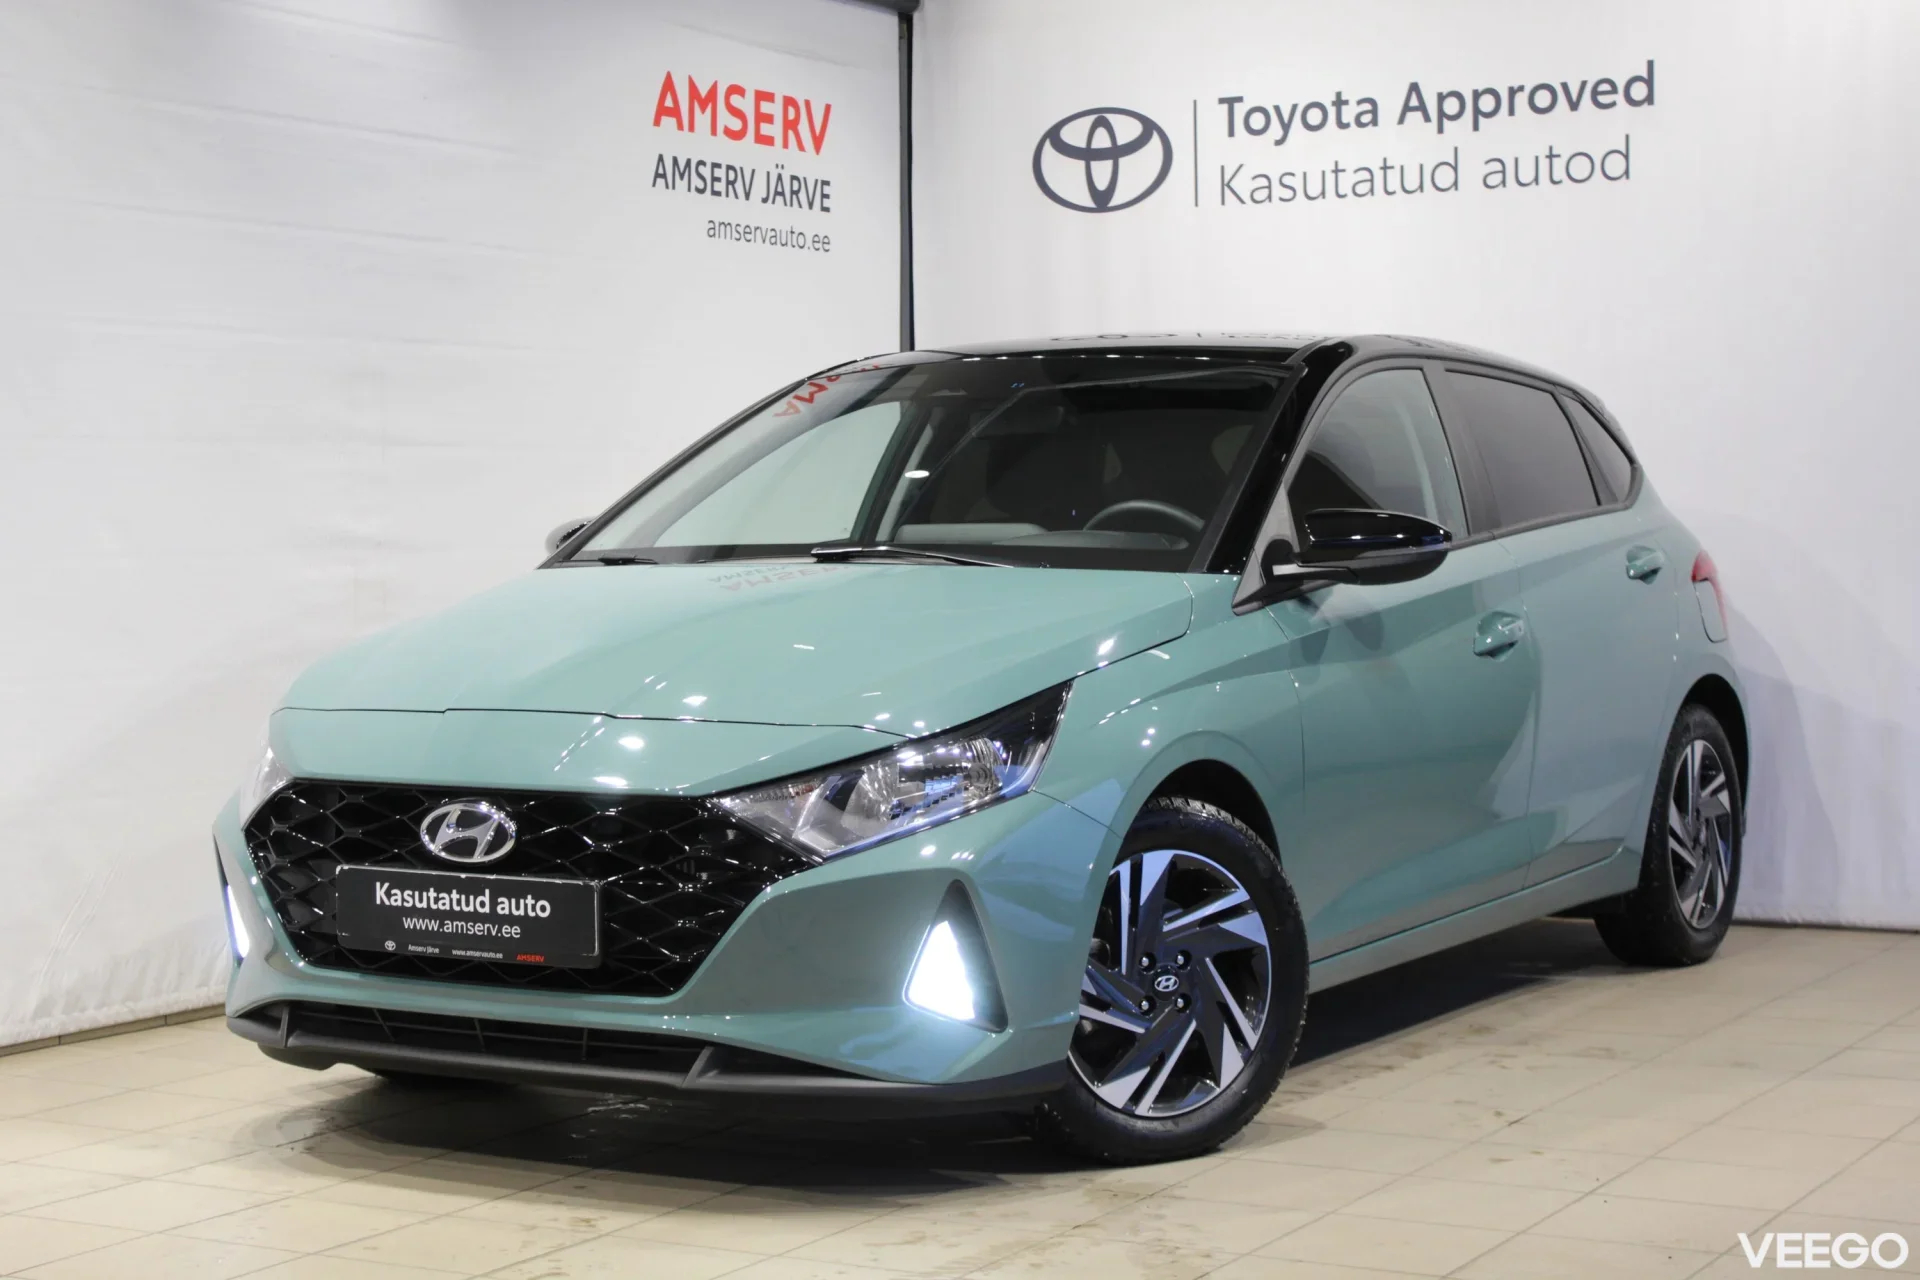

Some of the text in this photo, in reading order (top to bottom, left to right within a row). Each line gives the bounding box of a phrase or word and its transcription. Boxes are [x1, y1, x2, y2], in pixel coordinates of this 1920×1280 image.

[653, 70, 832, 156] AMSERV
[1218, 59, 1655, 146] Toyota Approved
[652, 153, 831, 213] AMSERV JÄRVE
[1219, 134, 1631, 206] Kasutatud autod
[706, 219, 831, 252] amservauto.ee
[375, 882, 552, 918] Kasutatud auto
[403, 916, 521, 938] www.amserv.ee
[408, 944, 426, 953] Amserv
[451, 948, 504, 959] www.amservauto.ee
[516, 954, 545, 962] AMSERV
